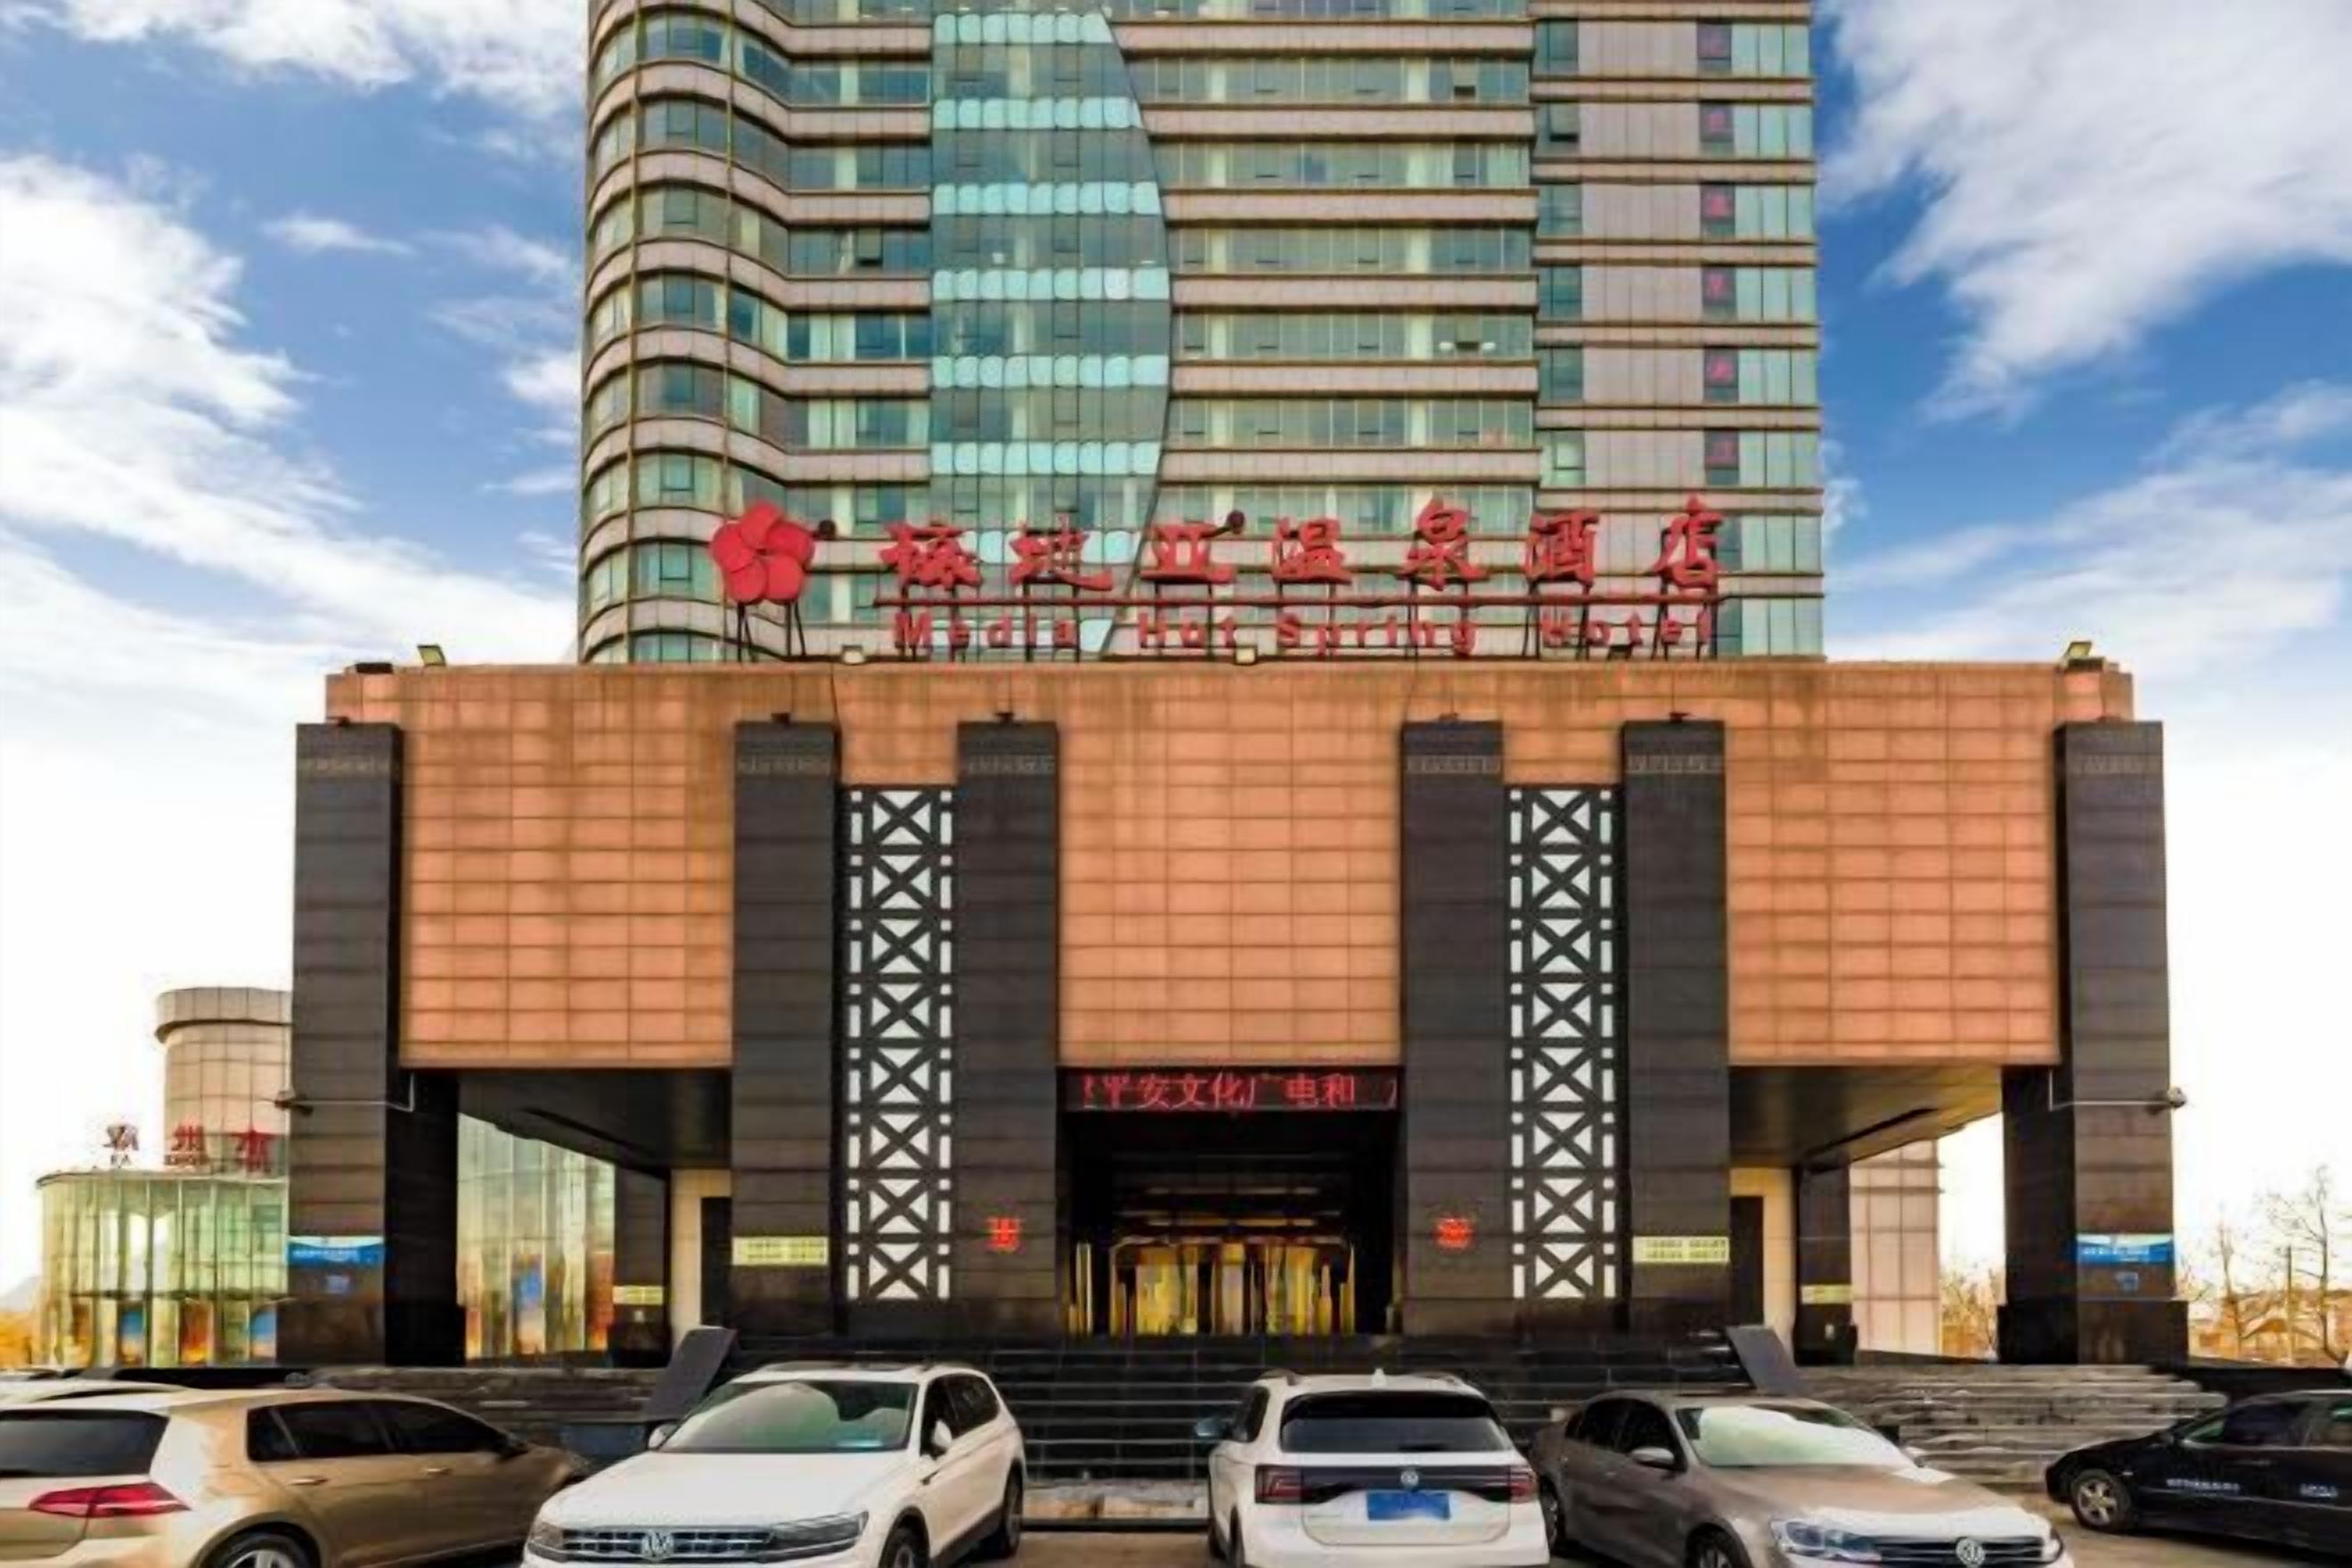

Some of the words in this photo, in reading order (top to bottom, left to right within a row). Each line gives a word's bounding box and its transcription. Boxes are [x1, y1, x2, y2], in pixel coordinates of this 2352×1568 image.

[894, 610, 1078, 650] Media
[1137, 611, 1237, 649] Hot
[1277, 612, 1475, 657] Spring
[1540, 611, 1712, 646] Hotel
